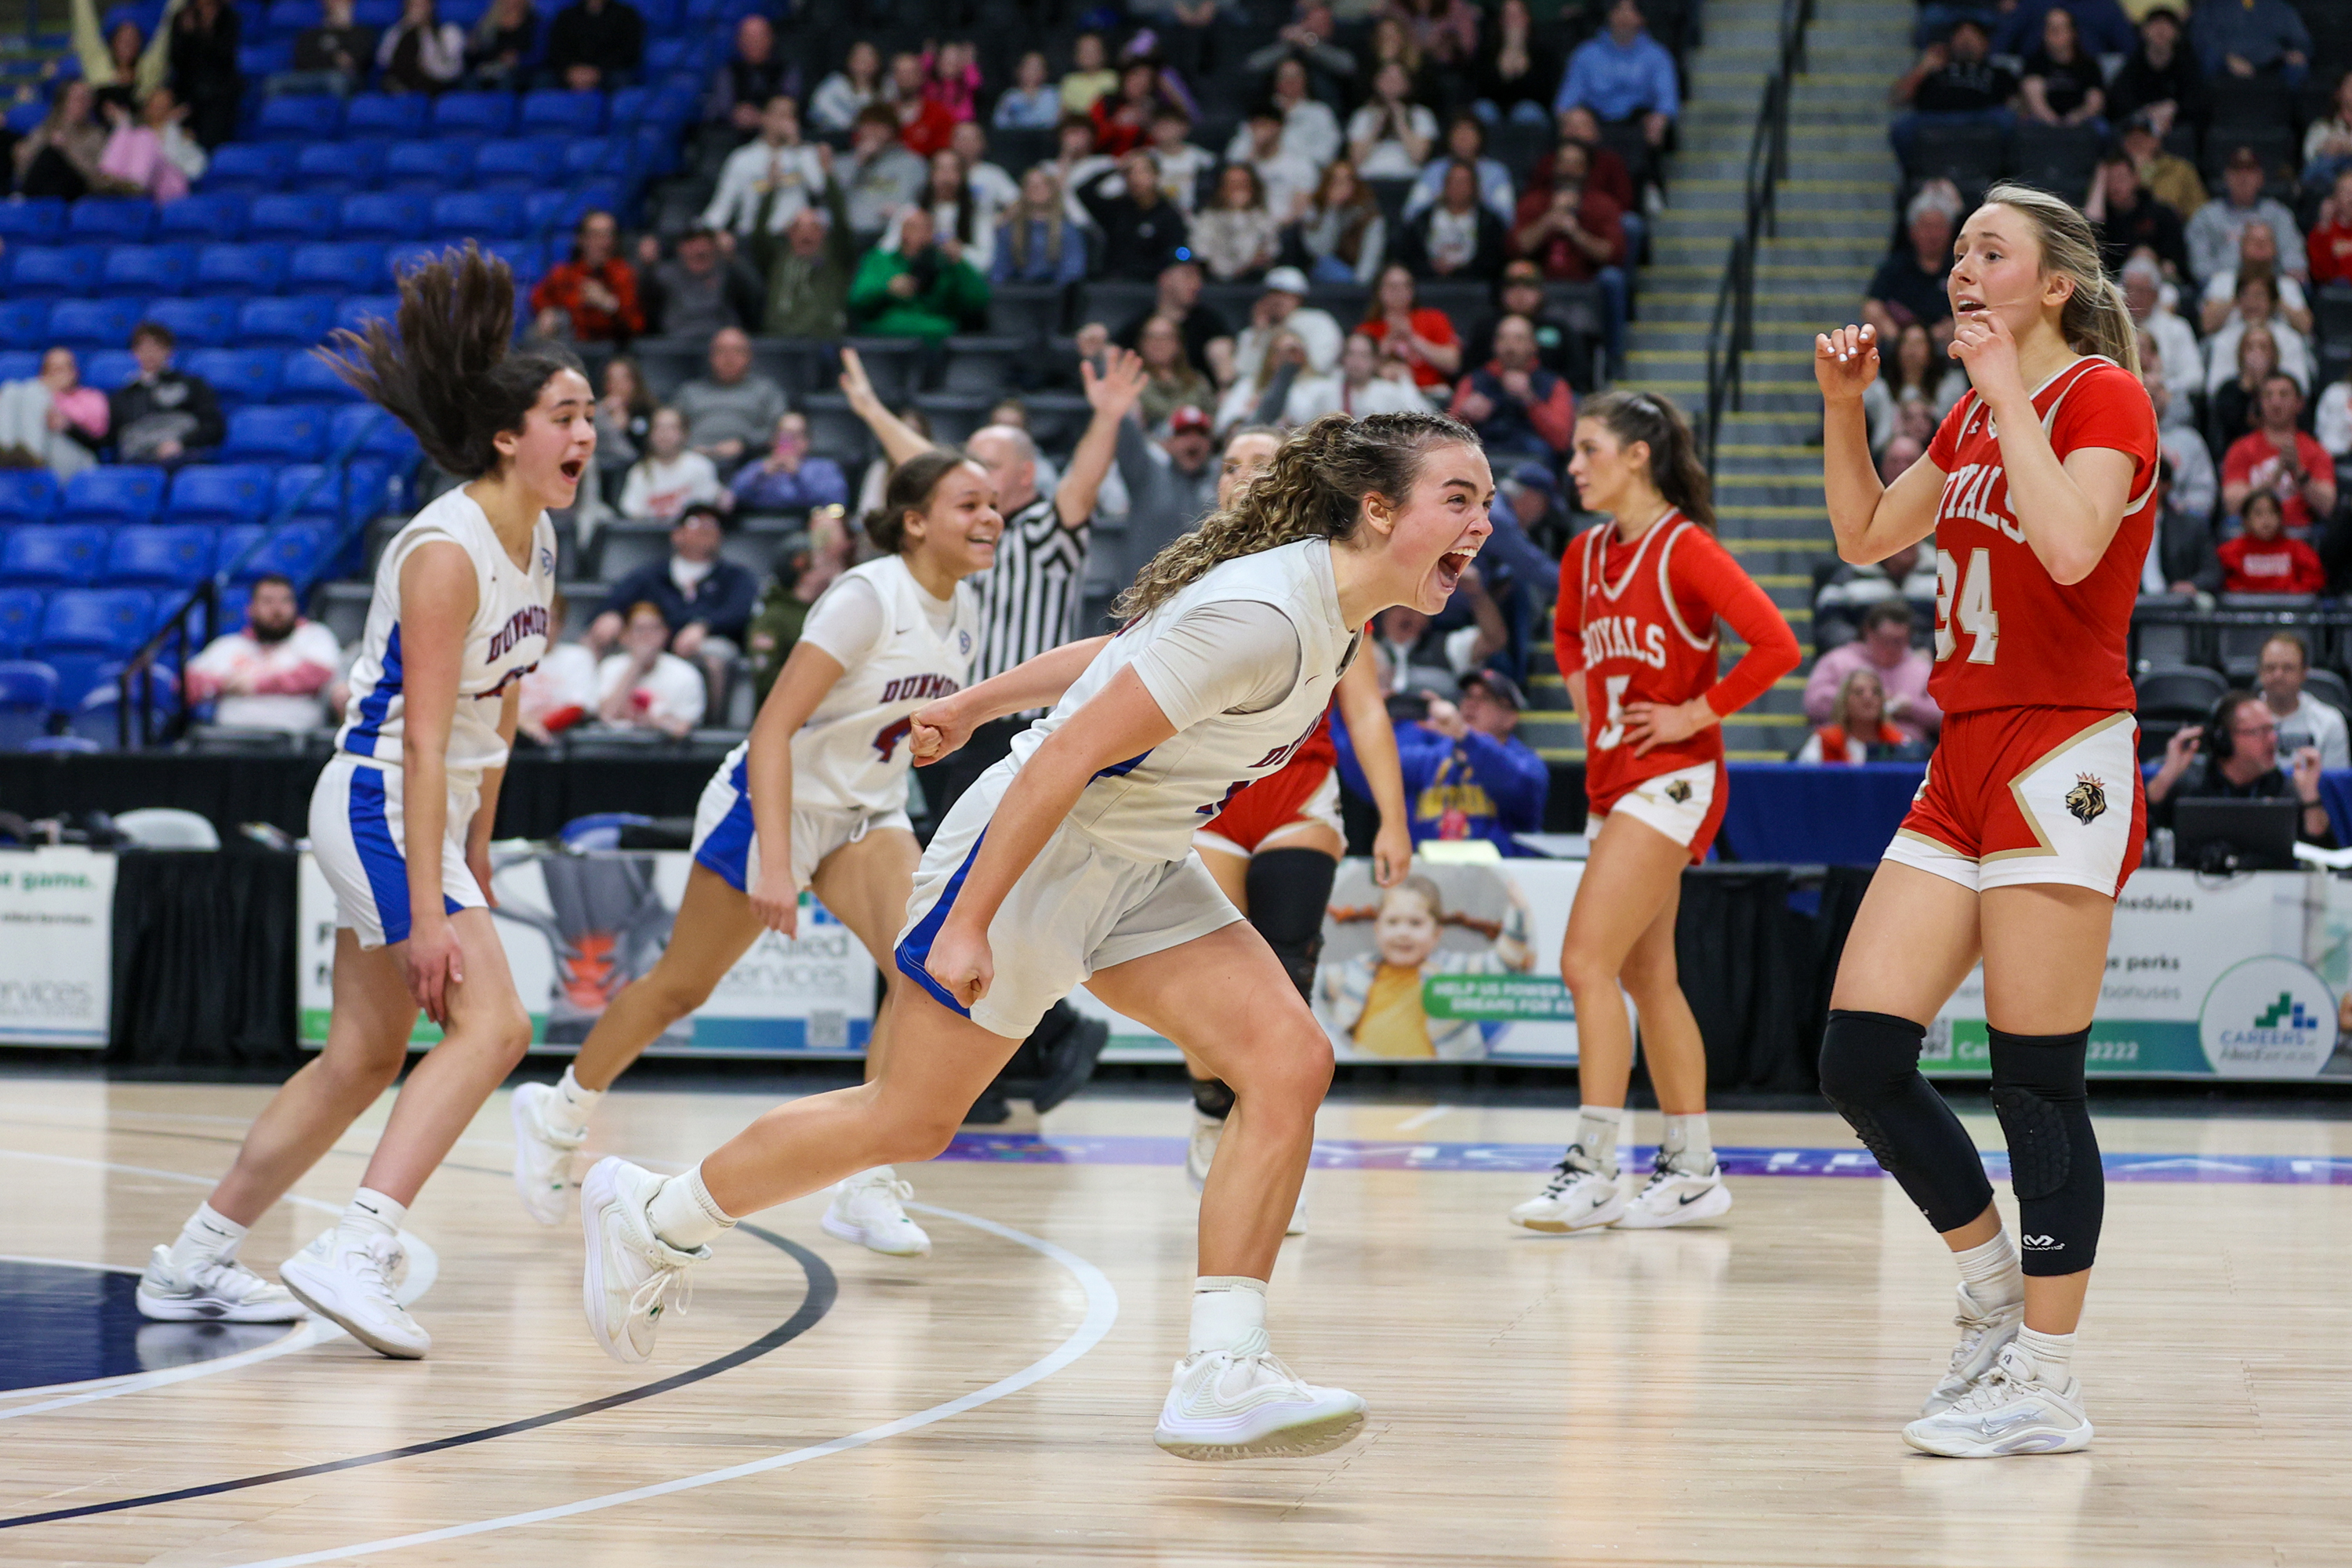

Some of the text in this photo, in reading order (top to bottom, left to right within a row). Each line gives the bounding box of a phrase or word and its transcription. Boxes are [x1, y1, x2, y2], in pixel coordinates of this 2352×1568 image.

[2116, 895, 2193, 911] hedules
[2126, 954, 2180, 971] perks
[724, 964, 847, 985] ervices
[2220, 1029, 2306, 1046] CAREERS
